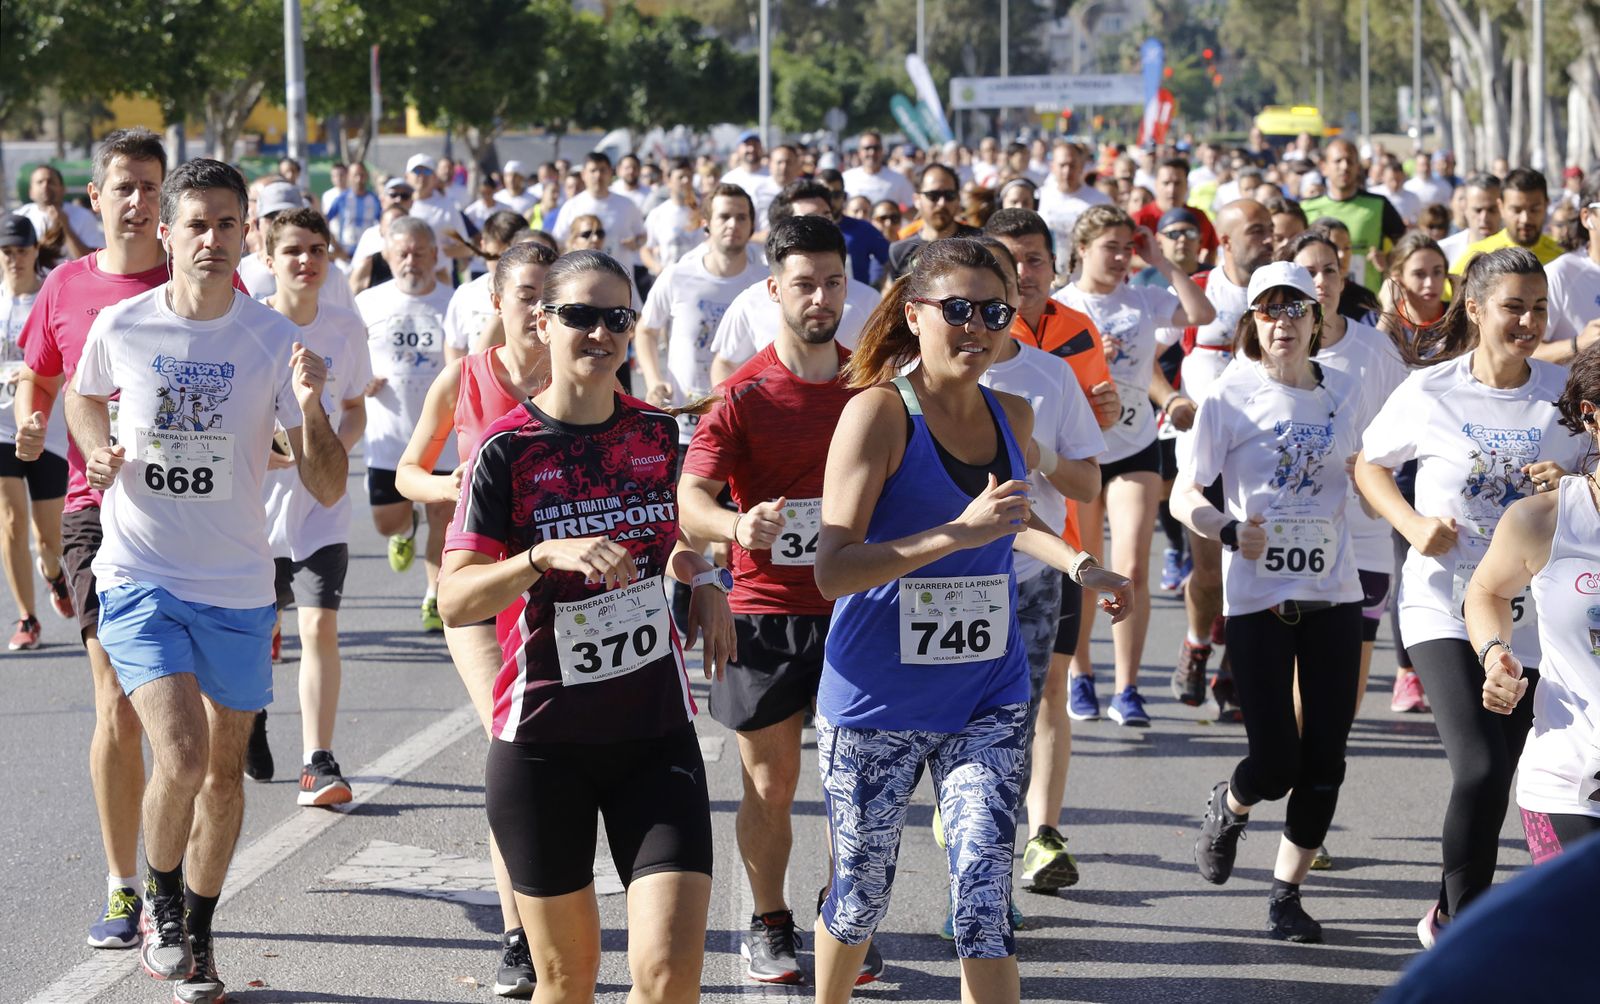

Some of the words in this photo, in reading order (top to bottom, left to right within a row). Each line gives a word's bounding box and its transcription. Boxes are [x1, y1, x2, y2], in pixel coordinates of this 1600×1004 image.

[393, 332, 433, 347] 303
[148, 431, 178, 440] CARRERA
[631, 454, 666, 466] inacua
[145, 463, 214, 494] 668
[534, 506, 559, 522] CLUB
[562, 503, 575, 516] DE
[576, 496, 622, 515] TRIATLON
[536, 502, 676, 542] TRISPORT
[1265, 547, 1325, 573] 506
[976, 579, 1003, 588] PRENSA
[566, 599, 604, 613] CARRERA
[604, 595, 615, 603] DE
[616, 591, 626, 600] LA
[627, 581, 656, 596] PRENSA
[571, 624, 658, 674] 370
[911, 619, 991, 655] 746
